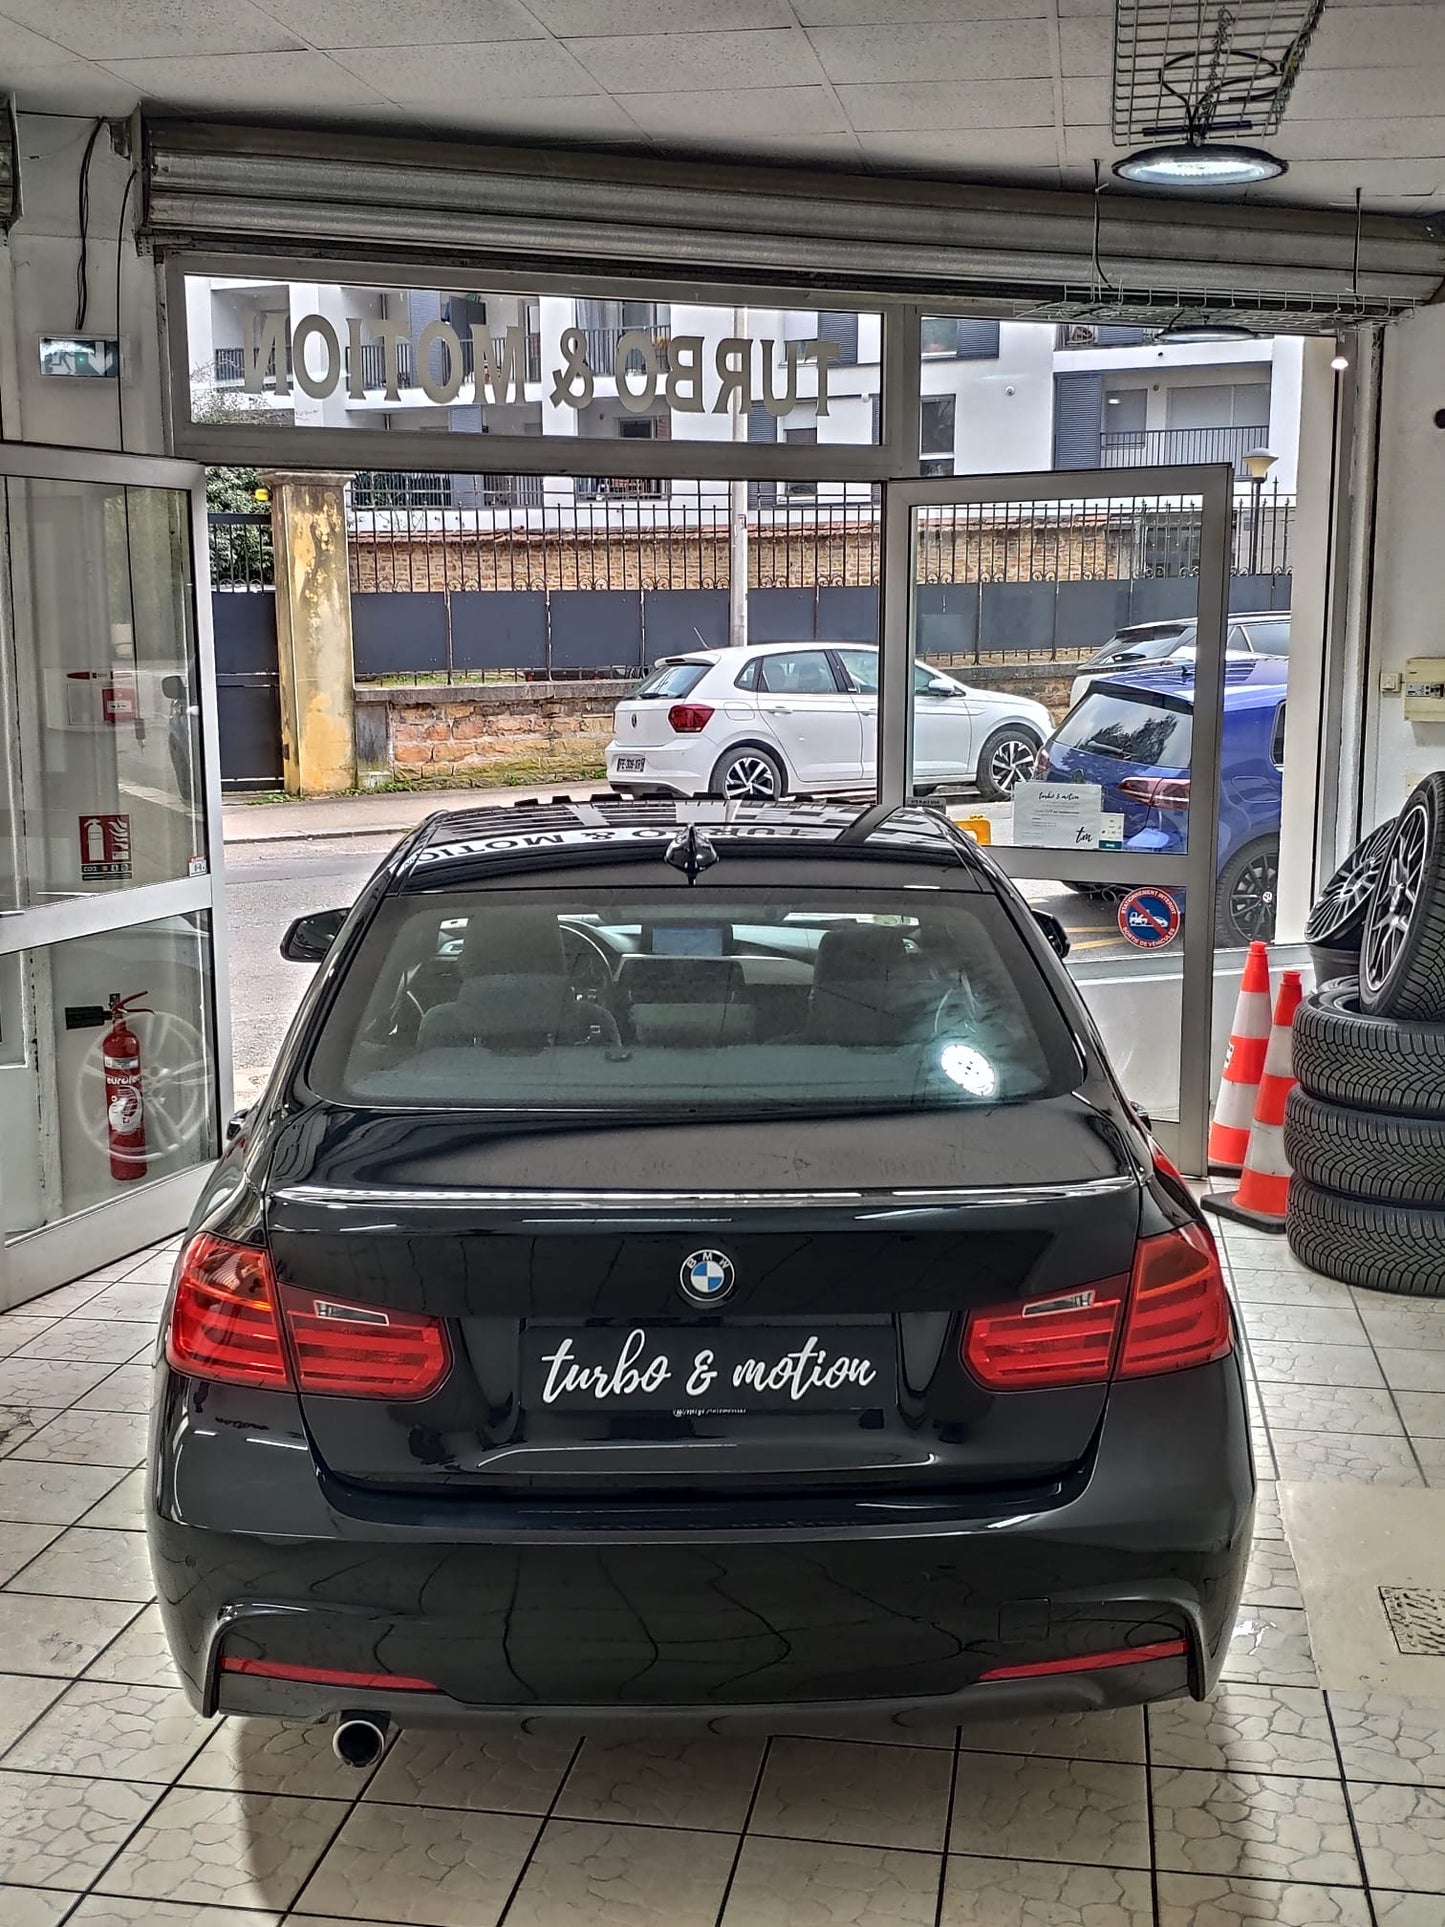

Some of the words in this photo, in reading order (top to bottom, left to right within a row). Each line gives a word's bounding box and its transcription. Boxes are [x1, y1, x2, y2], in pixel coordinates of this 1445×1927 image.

[1158, 891, 1176, 914] INTERDIT
[1123, 926, 1139, 943] SORTIE
[686, 1251, 731, 1269] BMW
[541, 1329, 672, 1404] turbo
[685, 1350, 718, 1396] &
[732, 1336, 876, 1400] motion
